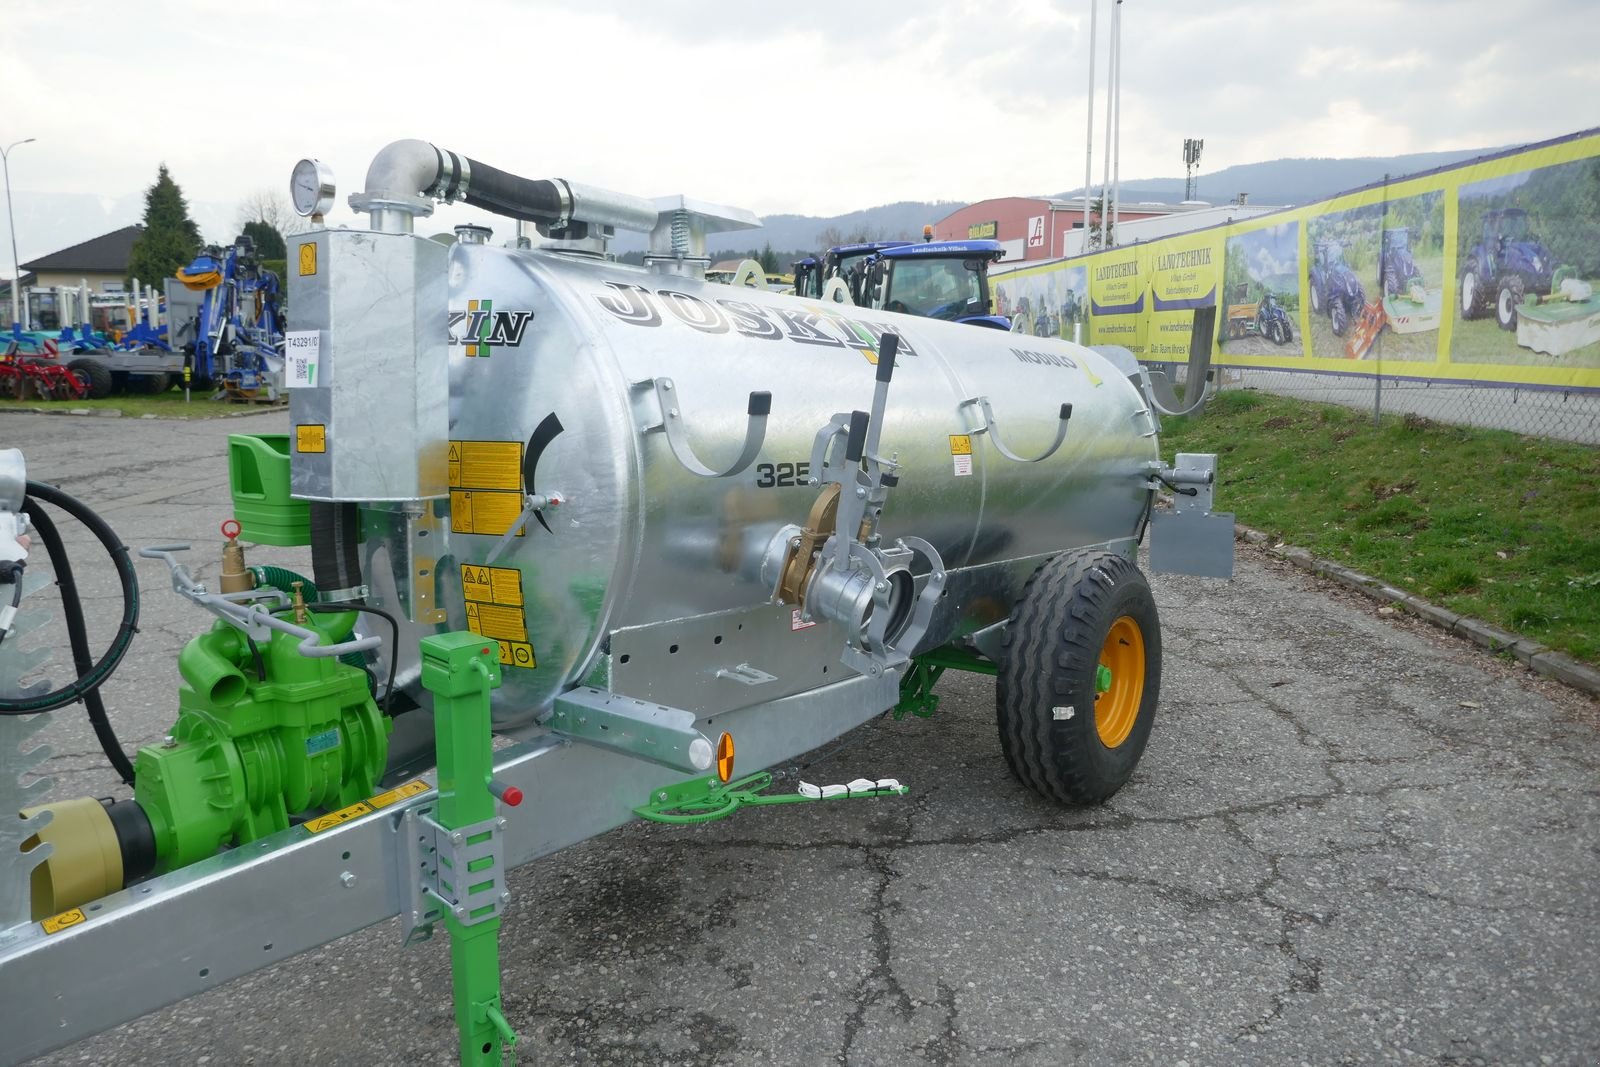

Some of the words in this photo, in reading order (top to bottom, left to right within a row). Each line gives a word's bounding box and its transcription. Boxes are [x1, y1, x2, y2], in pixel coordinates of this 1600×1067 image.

[1096, 261, 1138, 281] LANDTECHNIK
[1158, 248, 1212, 271] LANDTECHNIK
[591, 280, 918, 357] JOSKIN
[757, 462, 829, 488] 325
